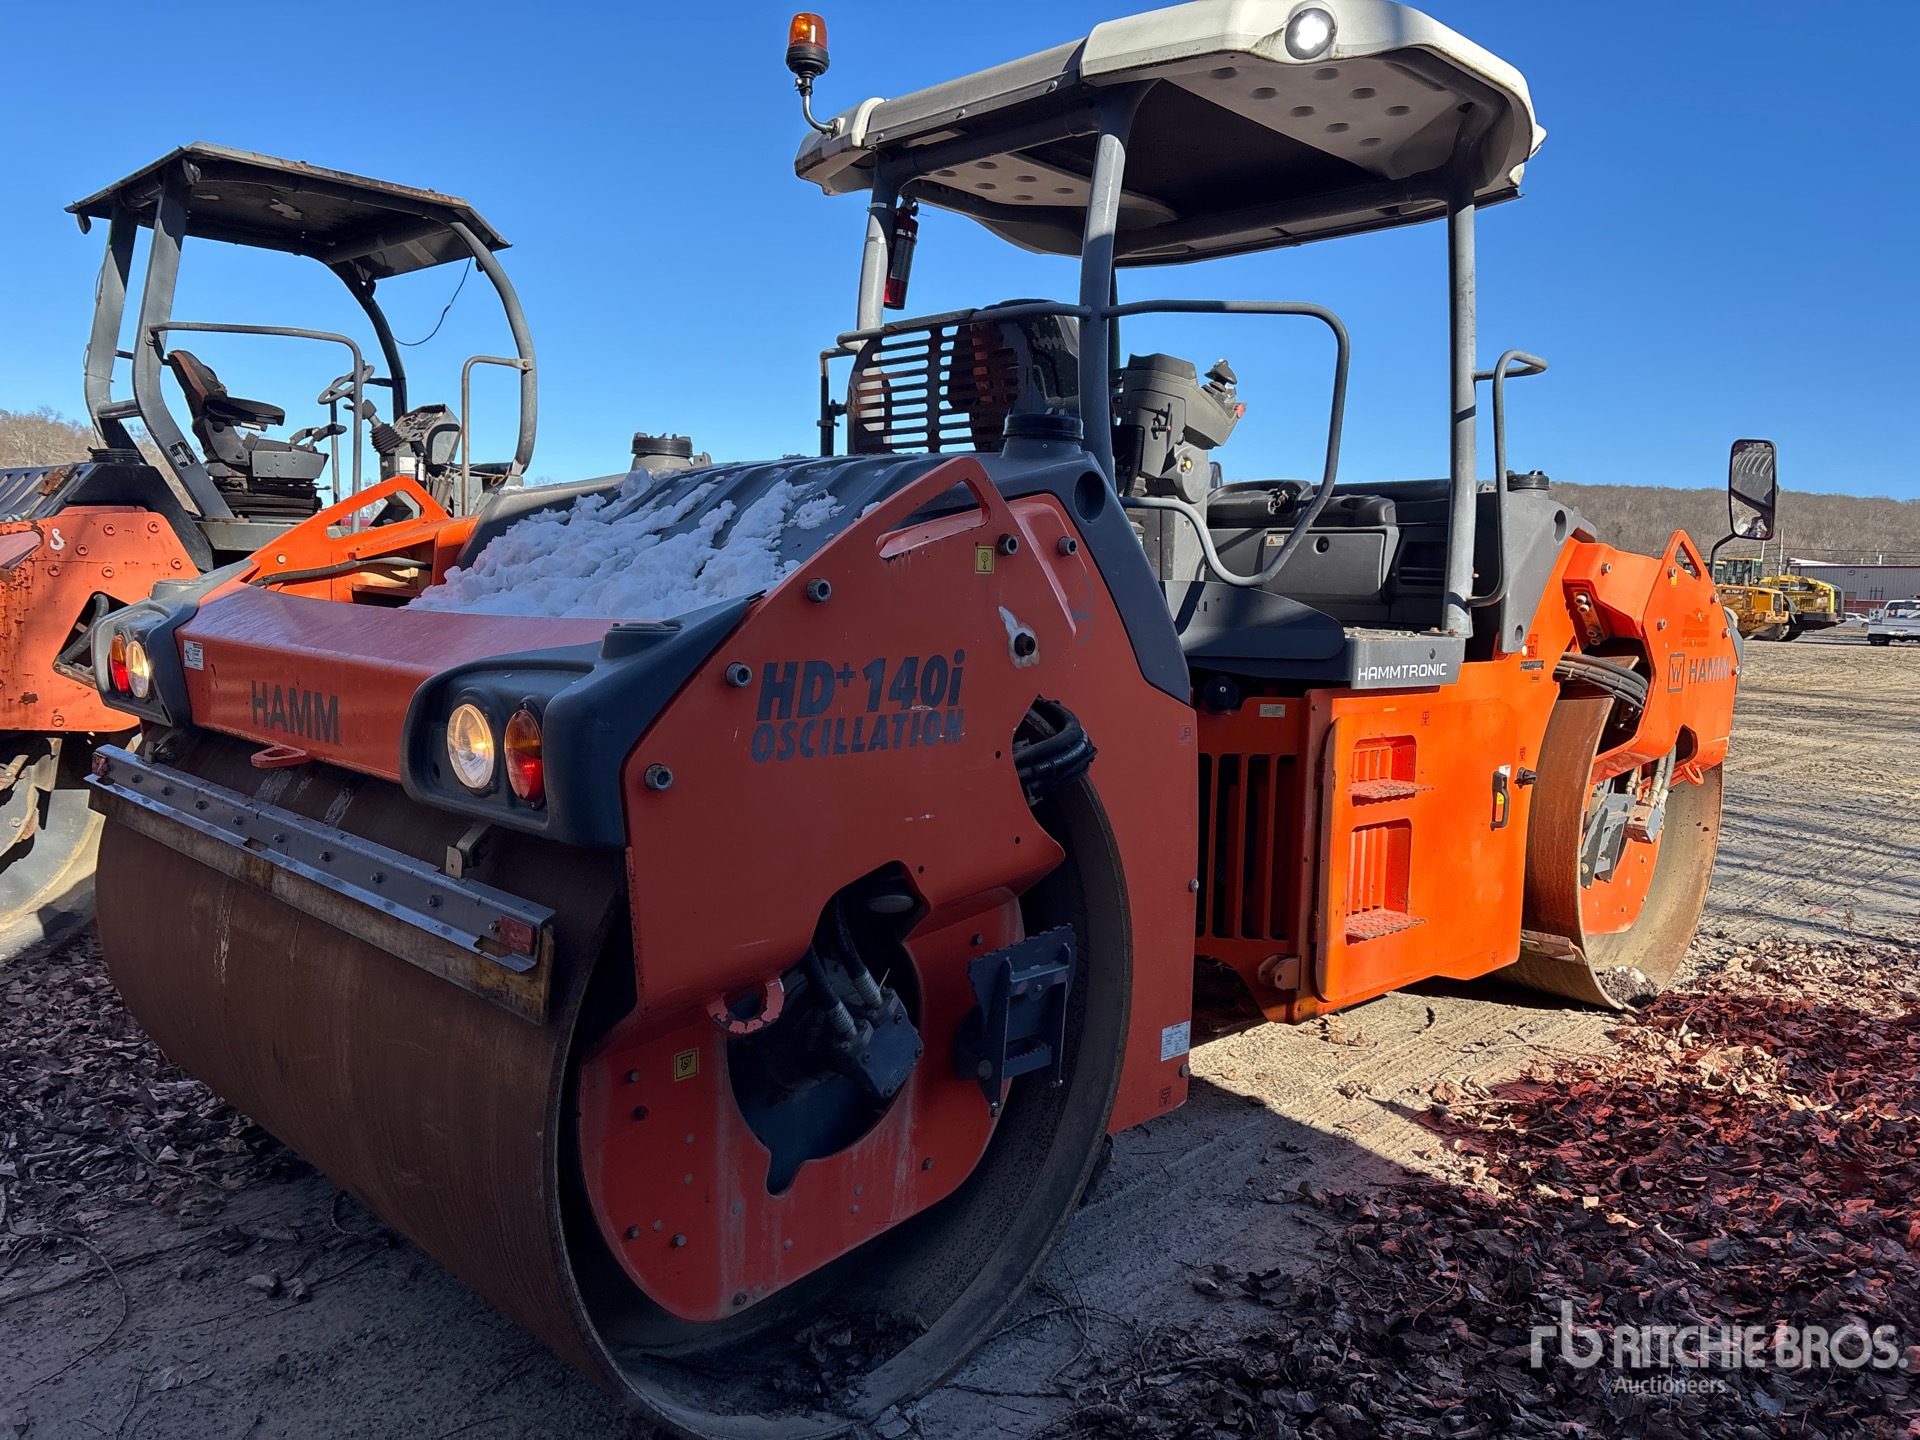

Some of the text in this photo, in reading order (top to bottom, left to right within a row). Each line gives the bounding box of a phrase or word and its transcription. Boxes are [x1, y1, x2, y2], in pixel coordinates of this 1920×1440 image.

[862, 649, 965, 712] 140i
[1357, 663, 1448, 681] HAMMTRONIC
[1688, 657, 1731, 684] HAMM
[252, 680, 339, 745] HAMM
[751, 709, 964, 763] OSCILLATION
